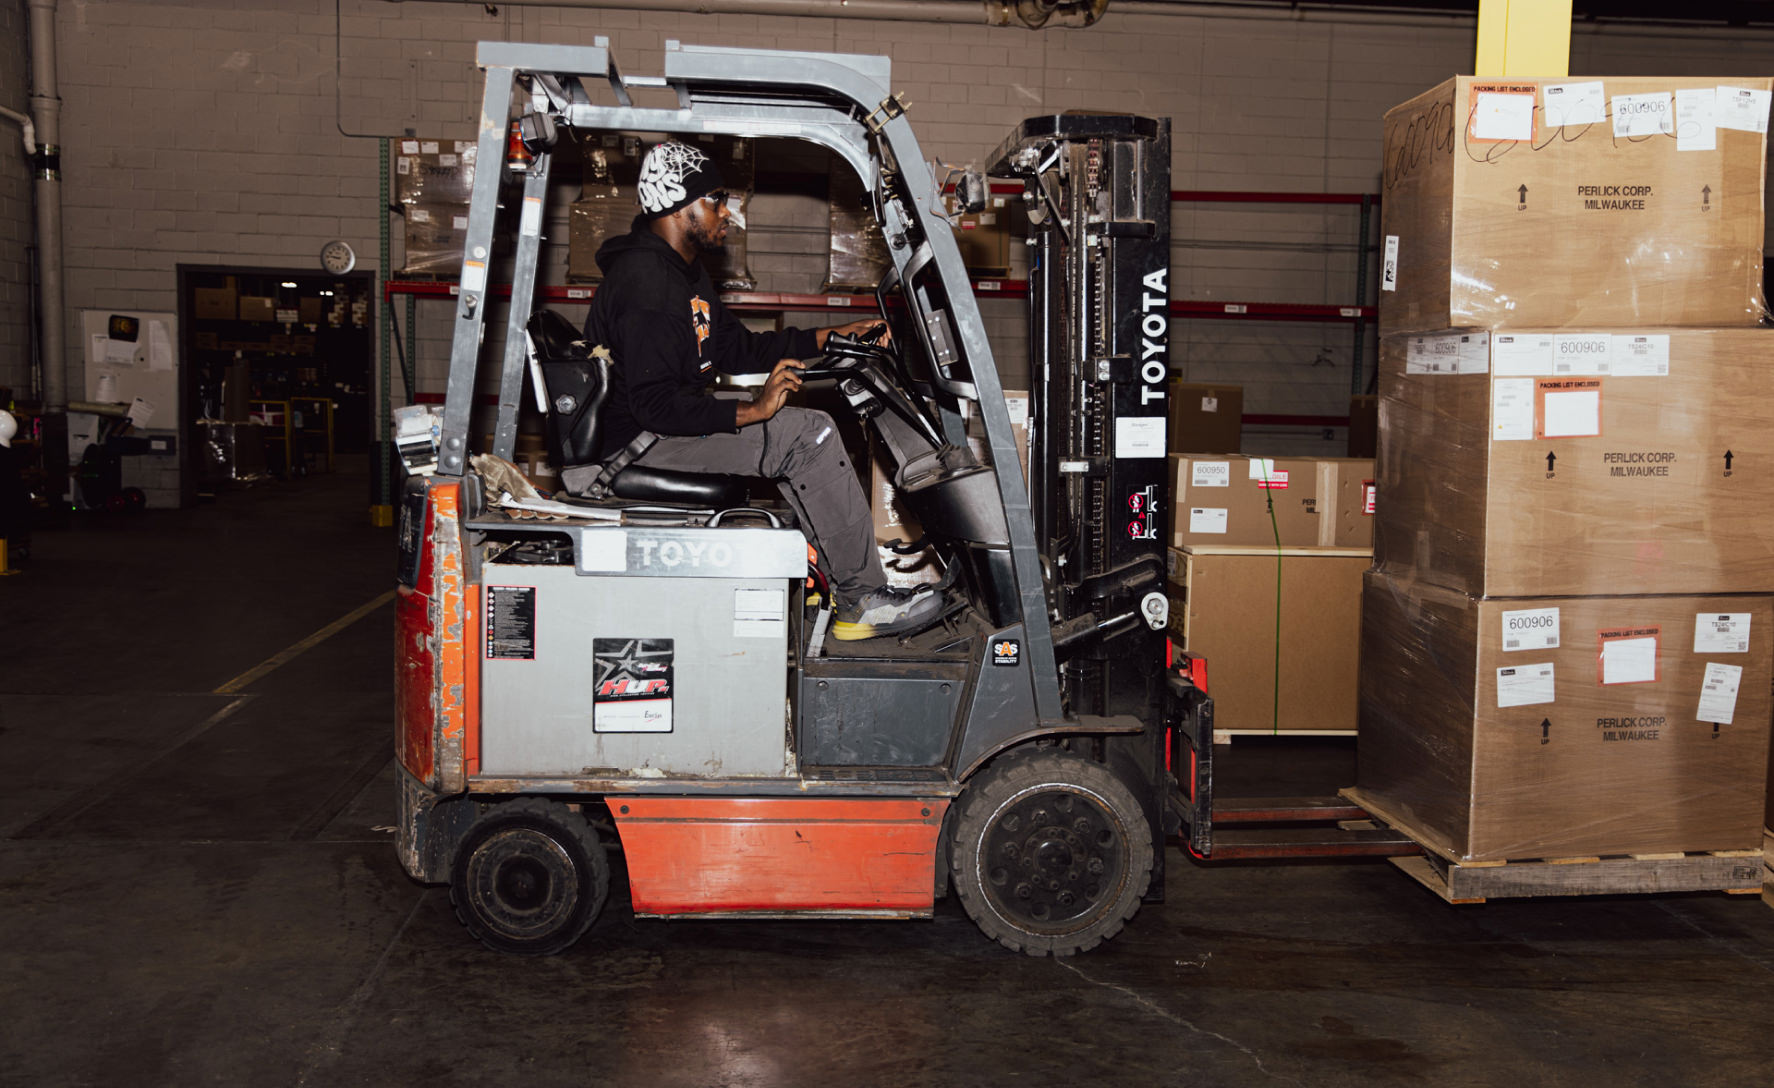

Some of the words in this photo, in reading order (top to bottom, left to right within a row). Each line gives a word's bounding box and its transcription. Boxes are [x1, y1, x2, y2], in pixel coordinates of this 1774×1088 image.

[1619, 101, 1665, 115] 600906
[1578, 186, 1620, 197] PERLICK
[1622, 186, 1654, 197] CORP.
[1584, 200, 1645, 210] MILWAUKEE
[1141, 267, 1167, 405] TOYOTA
[1560, 341, 1606, 354] 600906
[1539, 381, 1562, 389] PACKING
[1604, 453, 1644, 463] PERLICK
[1647, 452, 1677, 463] CORP.
[1197, 466, 1226, 474] 600950
[1610, 466, 1669, 477] MILWAUKEE
[1509, 615, 1554, 630] 600906
[994, 641, 1018, 656] SAS
[1597, 717, 1637, 728] PERLICK
[1638, 716, 1667, 727] CORP.
[1603, 730, 1660, 741] MILWAUKEE
